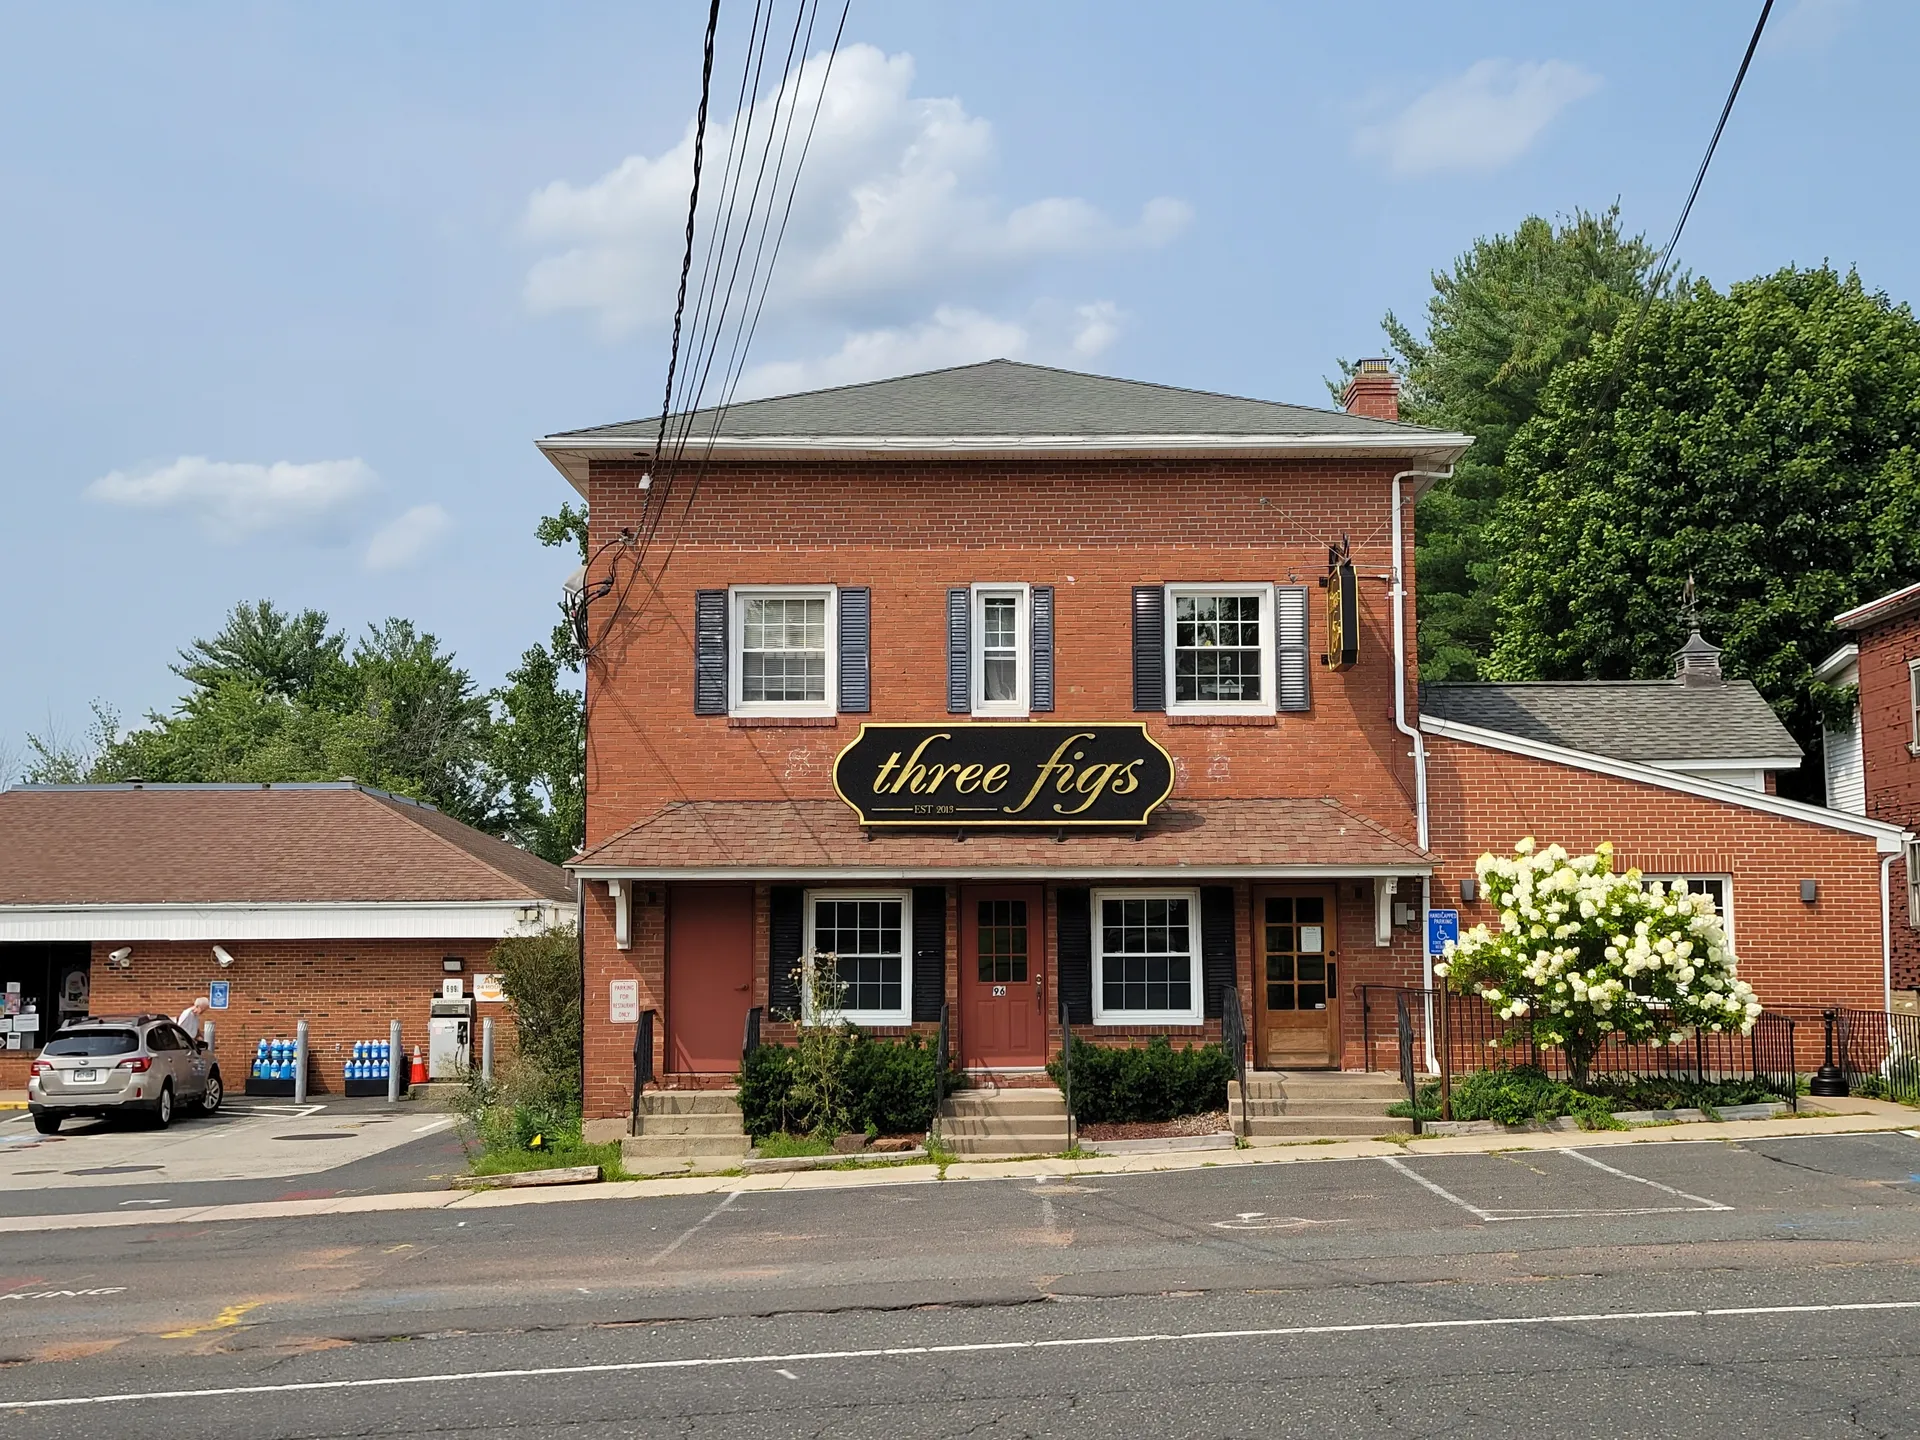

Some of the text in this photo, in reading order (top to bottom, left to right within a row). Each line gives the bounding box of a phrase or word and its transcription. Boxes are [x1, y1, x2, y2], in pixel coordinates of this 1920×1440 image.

[873, 733, 1144, 814] three figs
[914, 805, 954, 814] EST 2013
[994, 987, 1005, 996] 96
